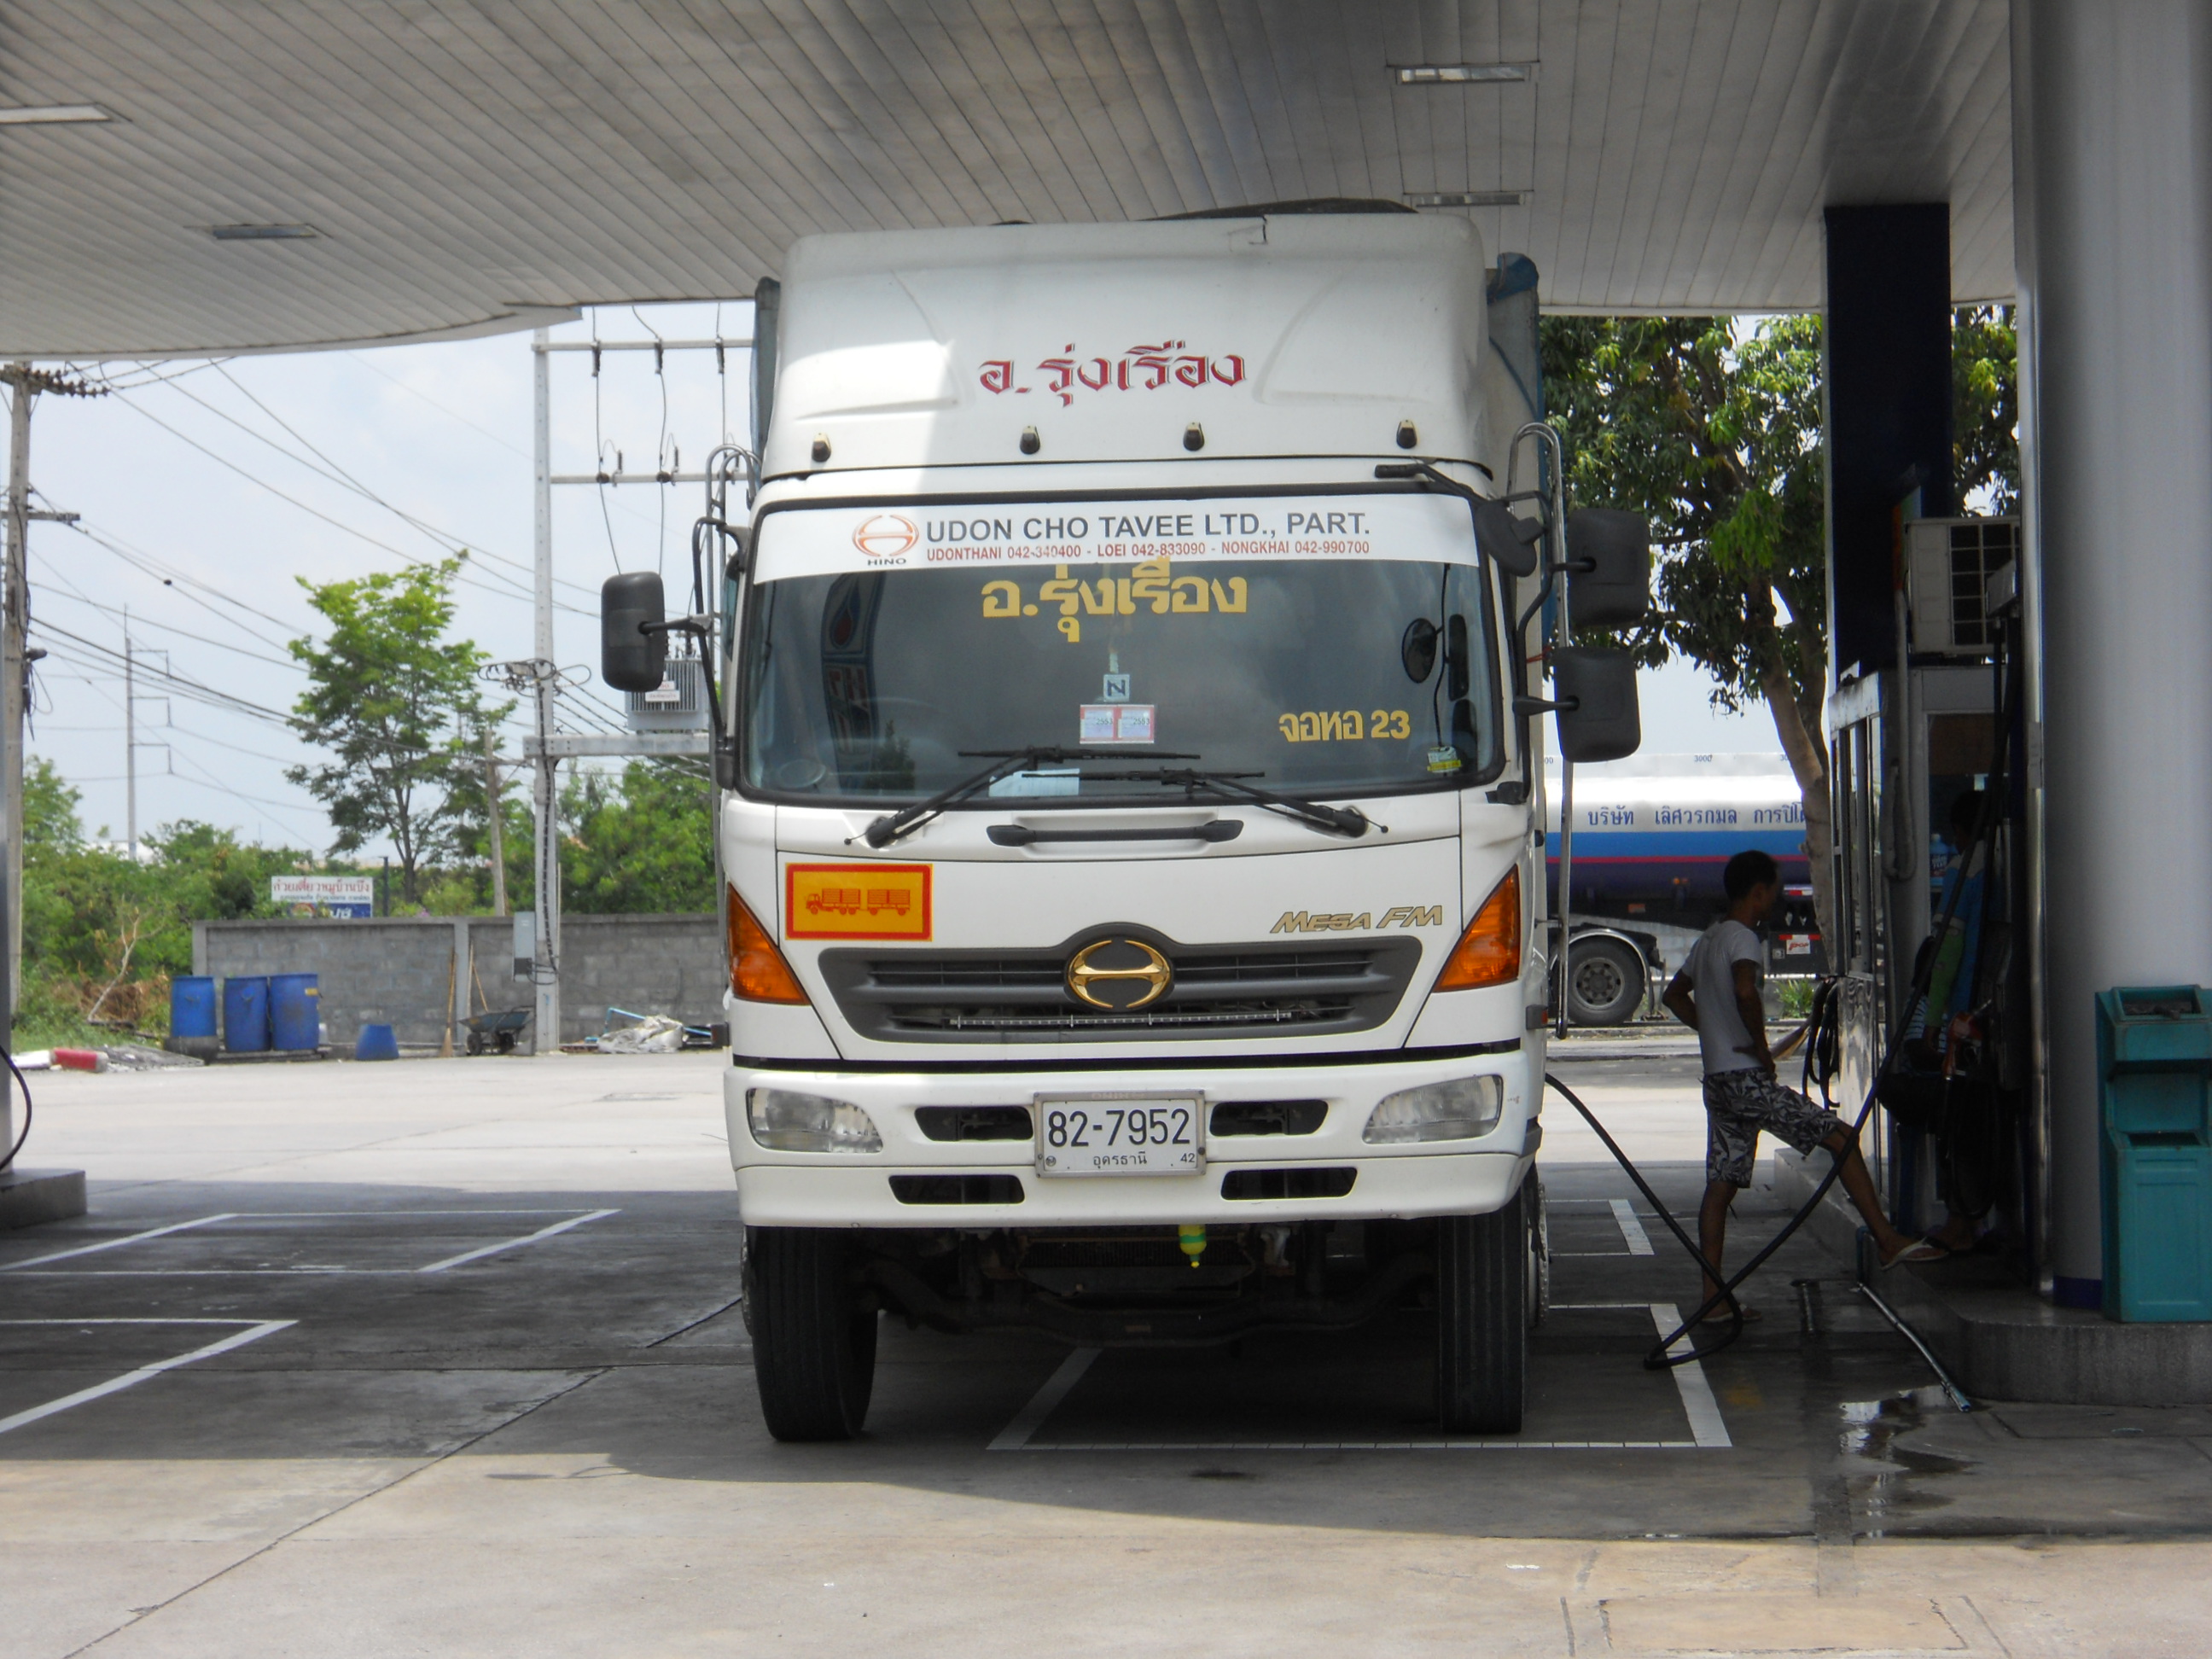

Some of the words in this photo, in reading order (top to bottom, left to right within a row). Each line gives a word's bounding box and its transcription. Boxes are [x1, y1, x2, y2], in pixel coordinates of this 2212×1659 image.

[979, 339, 1247, 408] อ.รุ่งเรือง
[927, 519, 1011, 542] UDON
[1023, 516, 1089, 539] CHO
[1098, 514, 1193, 538] TAVEE
[1205, 513, 1275, 538] LTD.,
[1288, 512, 1370, 534] PART.
[867, 557, 906, 566] HINO
[927, 546, 1001, 562] UDONTHANI
[1008, 544, 1081, 559] 042-340400
[1097, 544, 1126, 557] LOEI
[1132, 542, 1206, 557] 042-833090
[1221, 541, 1289, 555] NONGKHAI
[1295, 540, 1371, 554] 042-990700
[1107, 678, 1126, 696] N
[1371, 709, 1411, 740] 23
[1588, 804, 1634, 826] บริษัท
[1655, 805, 1738, 825] เลิศวรกมล
[1270, 911, 1371, 934] MESA
[1376, 905, 1443, 928] FM
[1048, 1108, 1190, 1147] 82-7952
[1093, 1151, 1147, 1169] อุดรธานี
[1180, 1152, 1196, 1163] 42
